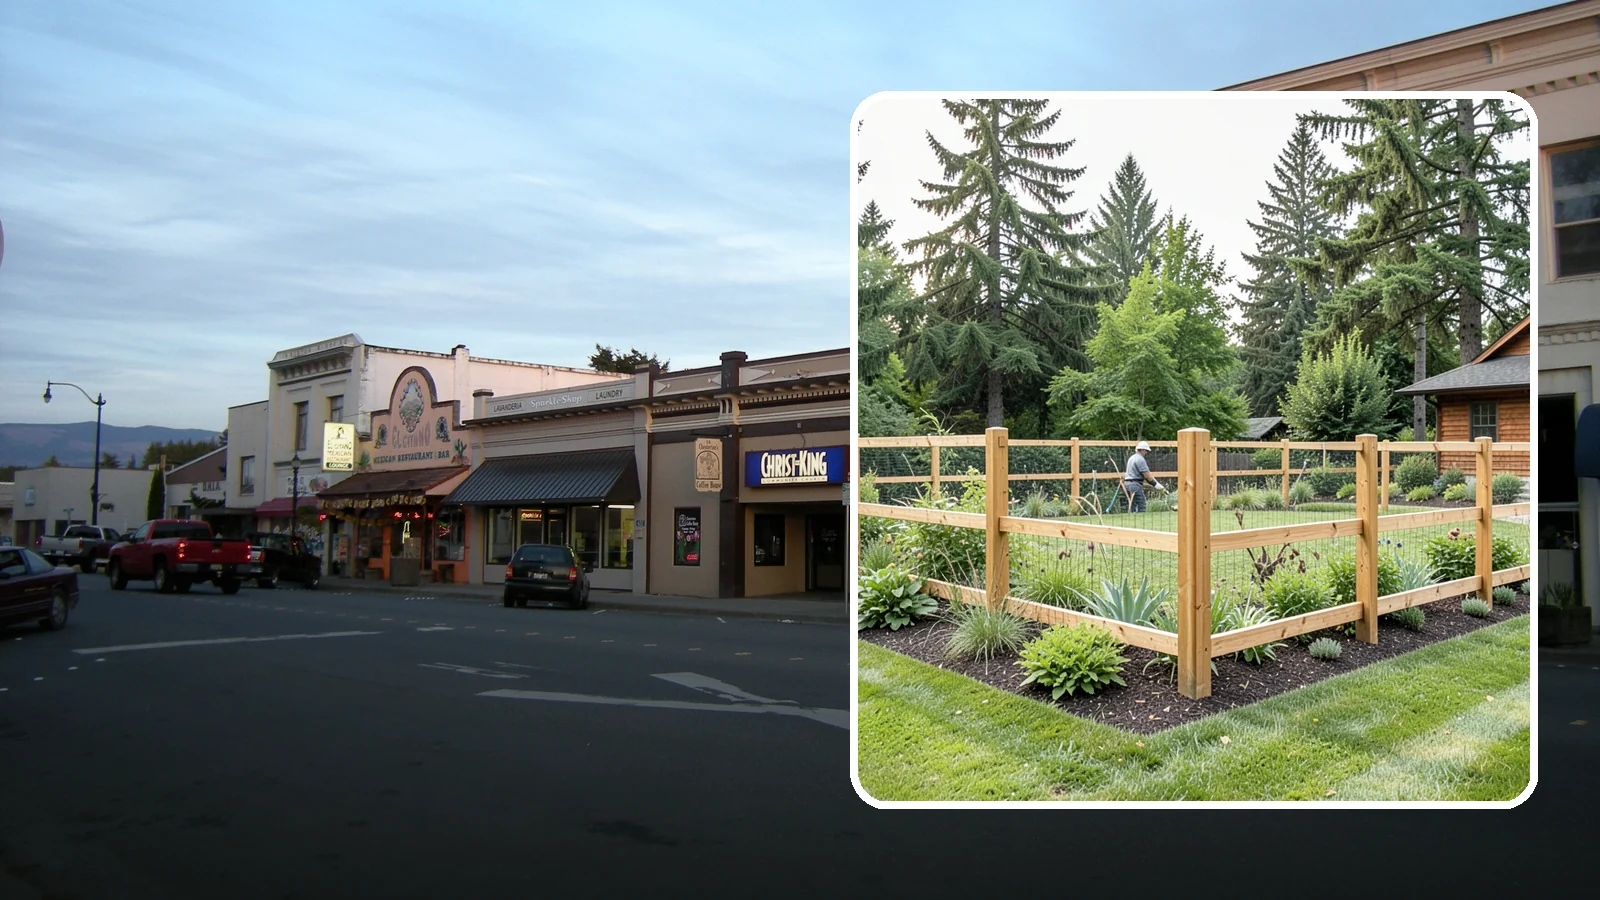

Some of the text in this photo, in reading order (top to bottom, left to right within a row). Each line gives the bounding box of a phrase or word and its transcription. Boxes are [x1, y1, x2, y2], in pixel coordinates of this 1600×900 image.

[561, 394, 582, 405] Shop
[595, 389, 623, 400] LAUNDRY
[494, 403, 522, 412] LAVANDERIA
[373, 450, 450, 464] MEXICAN RESTAURANT BAR
[696, 480, 709, 488] Coffee
